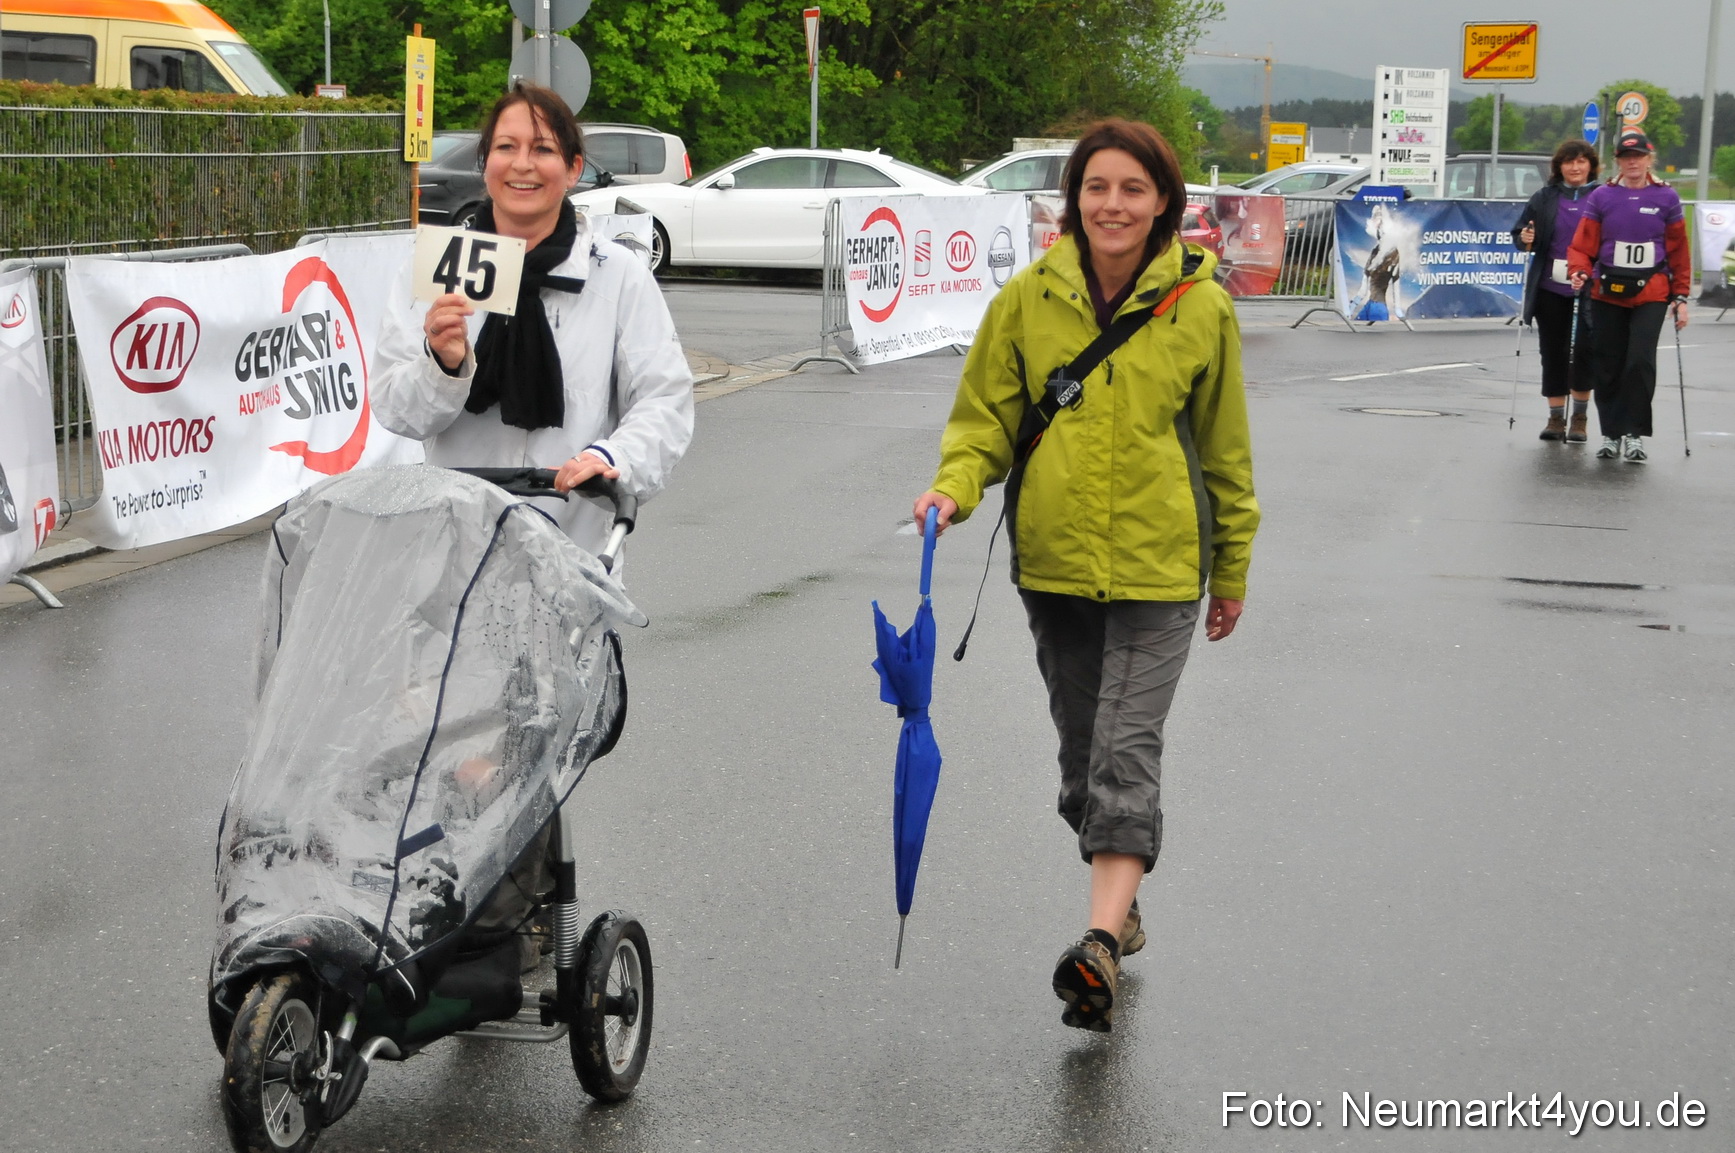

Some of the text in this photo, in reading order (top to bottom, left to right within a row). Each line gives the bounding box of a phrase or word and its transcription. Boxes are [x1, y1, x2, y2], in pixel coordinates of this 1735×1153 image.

[1471, 31, 1530, 48] Sengenthal
[1390, 109, 1405, 123] SHB
[1624, 102, 1640, 116] 60
[409, 131, 428, 158] 5 km
[1388, 149, 1411, 162] THULE
[1422, 230, 1494, 244] SAISONSTART
[846, 236, 895, 265] GERHART
[950, 241, 971, 263] KIA
[990, 252, 1013, 263] NISSAN
[1420, 251, 1452, 265] GANZ
[1454, 250, 1479, 264] WEIT
[1479, 251, 1510, 265] VORN
[1625, 245, 1645, 264] 10
[433, 235, 499, 302] 45
[866, 262, 900, 292] JÄNIG
[940, 278, 983, 294] KIA MOTORS
[1418, 271, 1523, 286] WINTERANGEBOTEN
[908, 283, 936, 298] SEAT
[335, 319, 346, 350] &
[126, 321, 186, 371] KIA
[1059, 383, 1079, 404] over
[98, 415, 217, 471] KIA MOTORS
[151, 489, 165, 511] to
